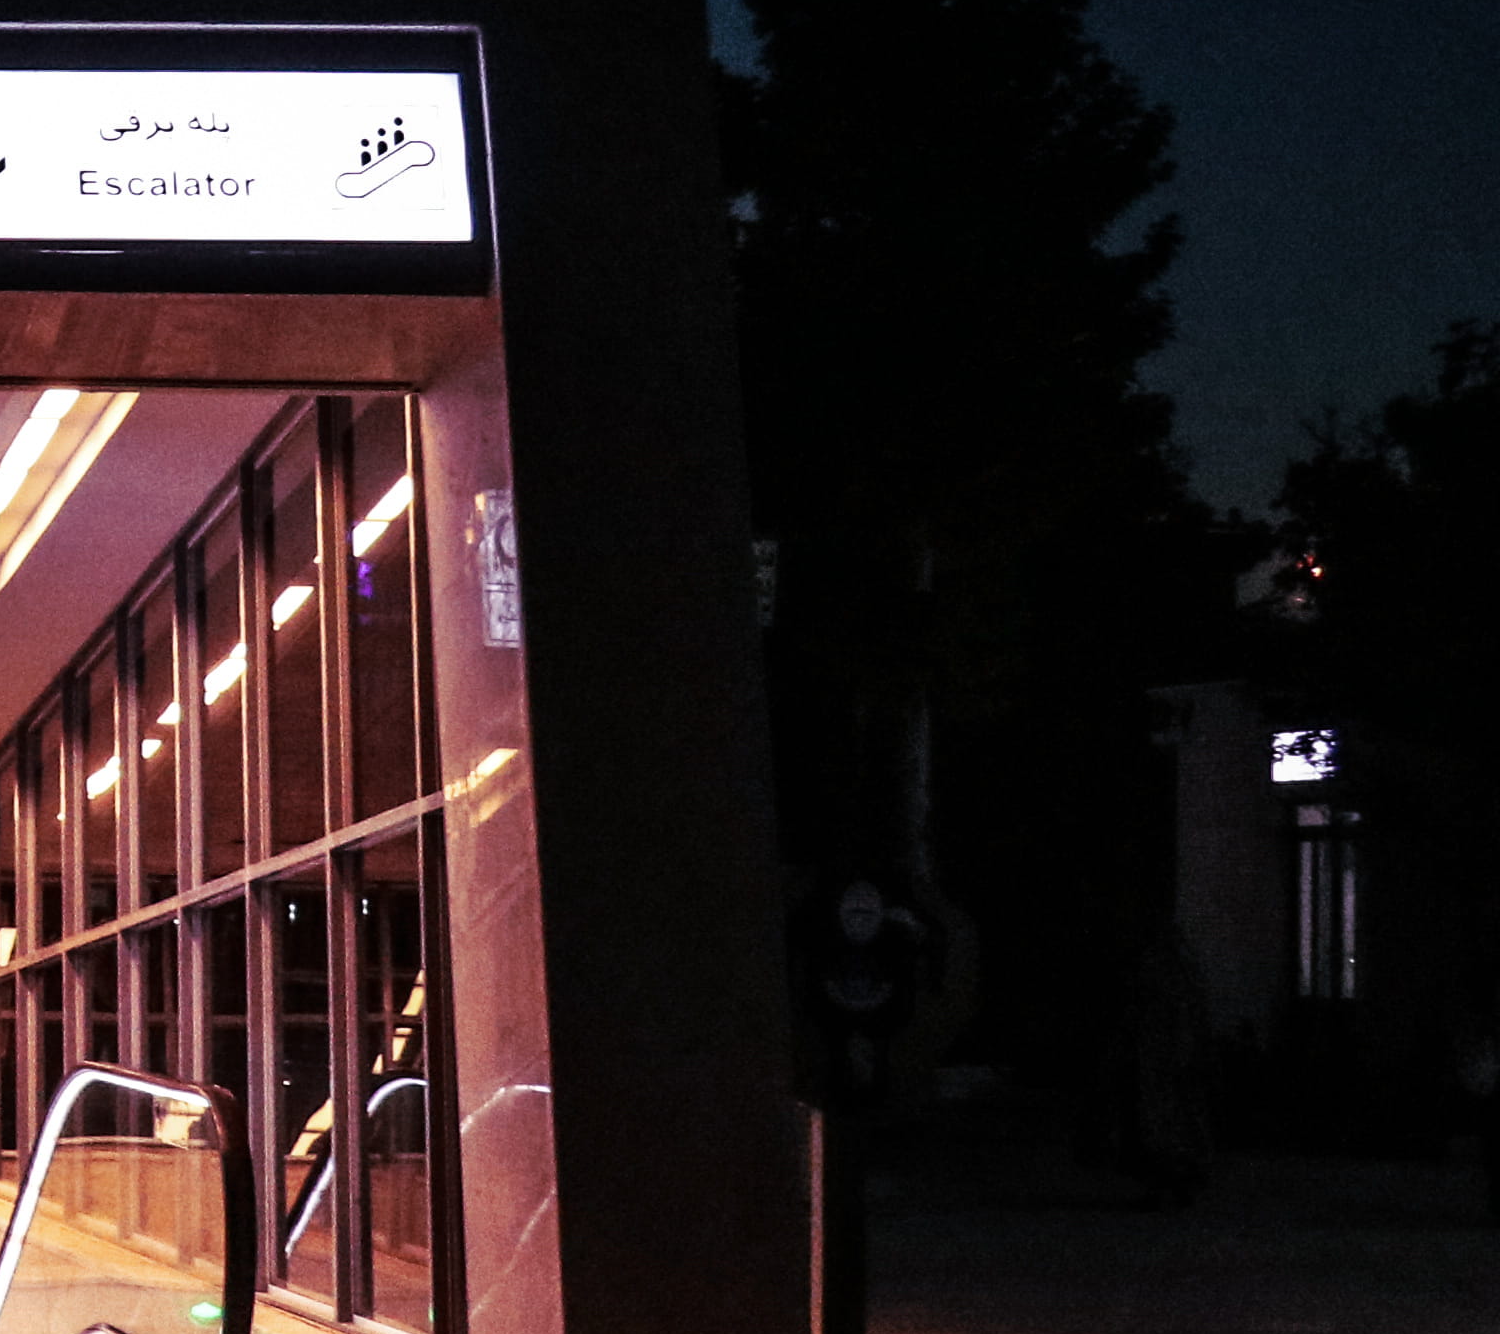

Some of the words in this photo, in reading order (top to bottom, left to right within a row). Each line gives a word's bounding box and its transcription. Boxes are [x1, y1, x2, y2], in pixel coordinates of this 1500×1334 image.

[98, 109, 176, 143] برقی
[187, 111, 232, 144] پله
[78, 169, 257, 198] Escalator
